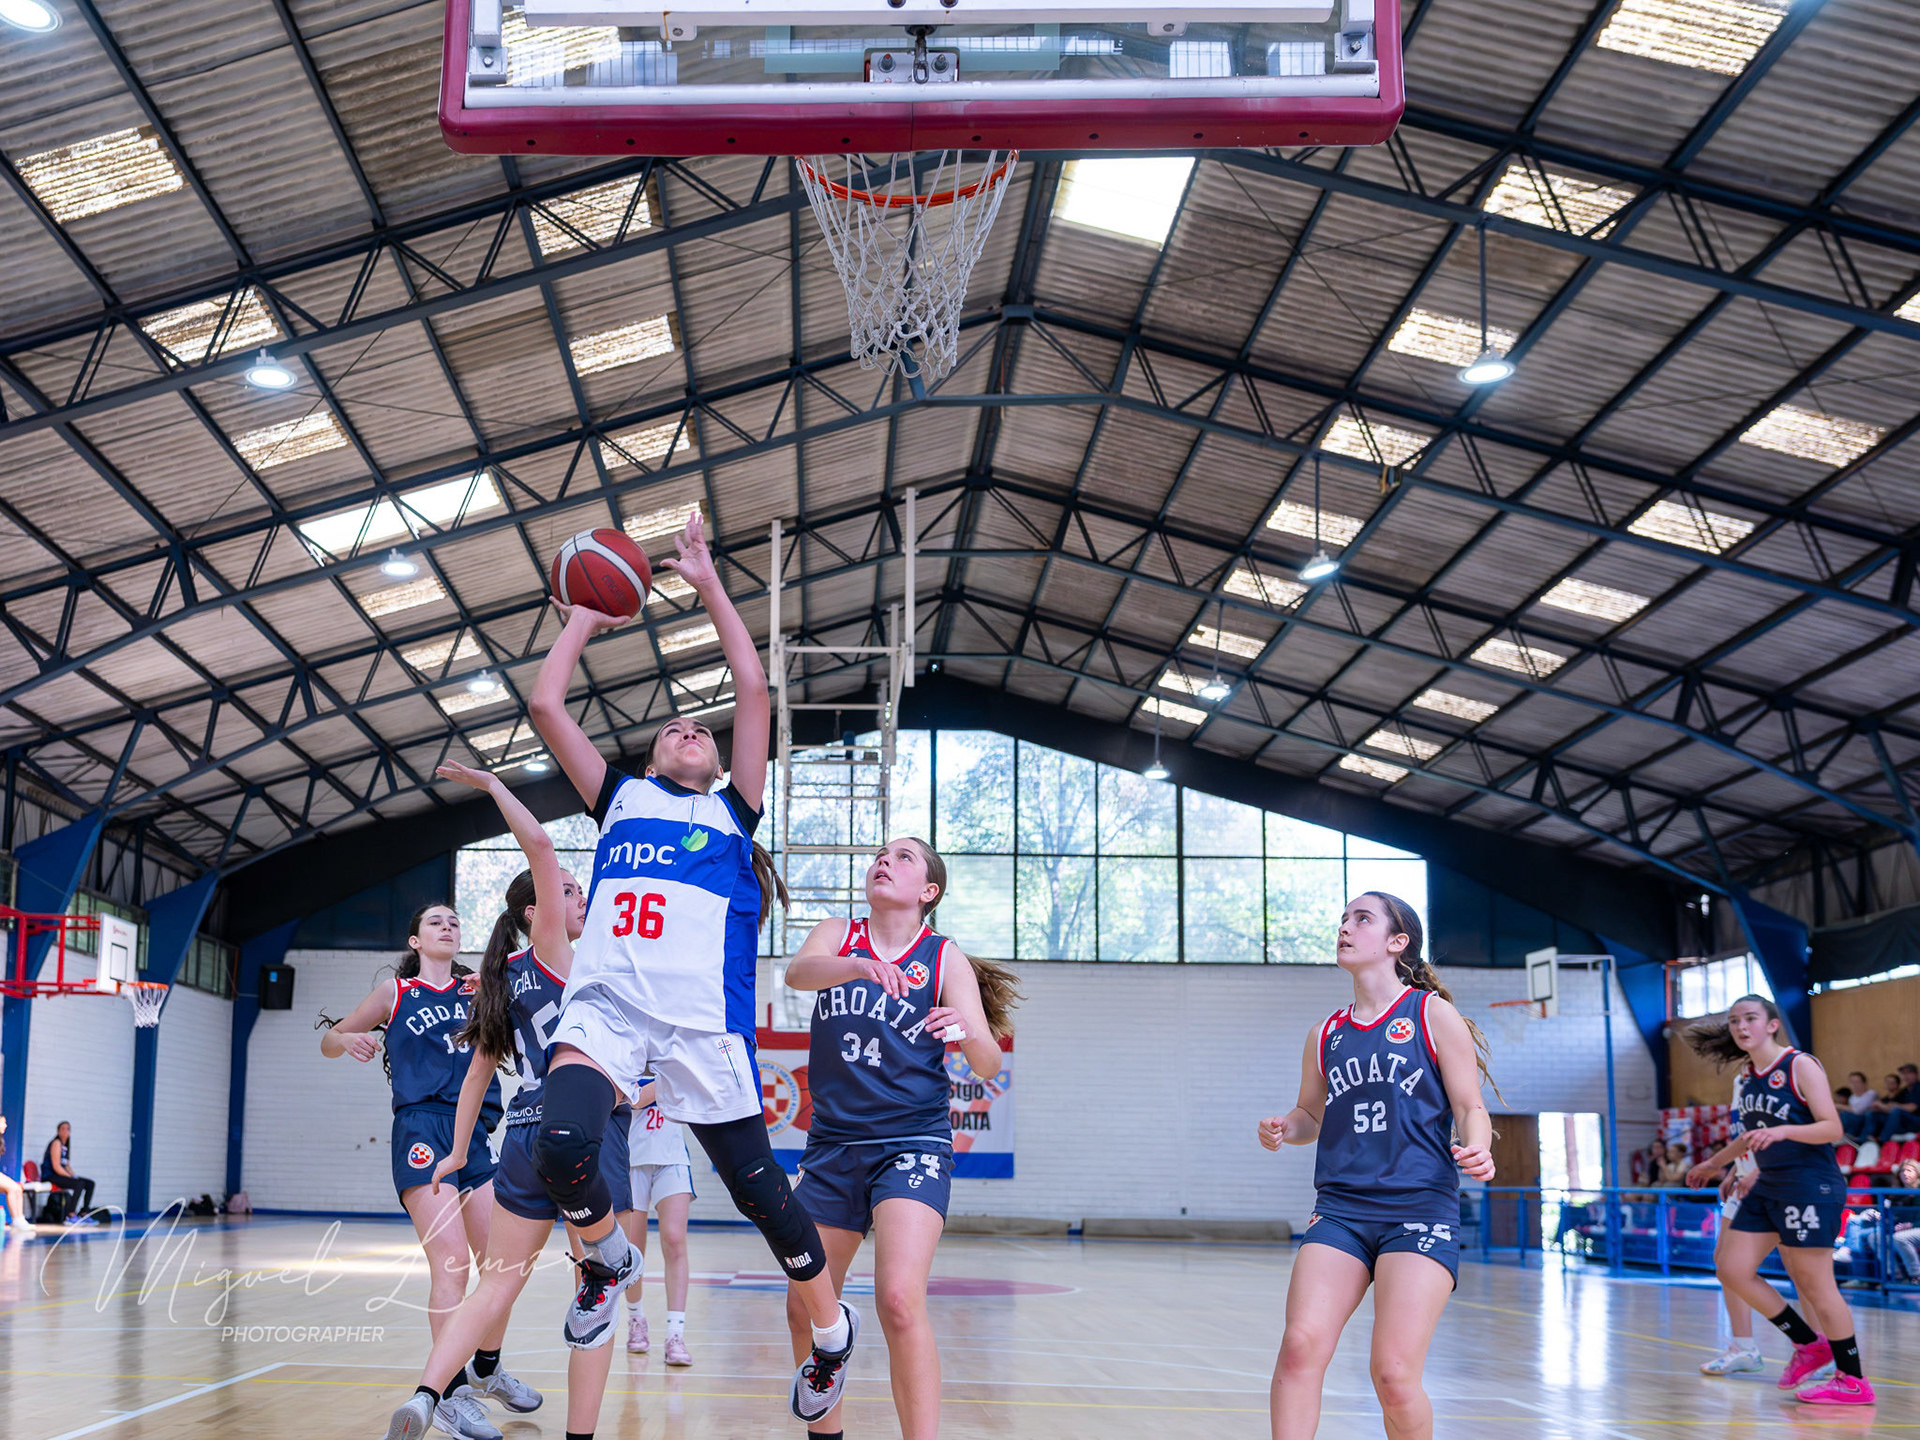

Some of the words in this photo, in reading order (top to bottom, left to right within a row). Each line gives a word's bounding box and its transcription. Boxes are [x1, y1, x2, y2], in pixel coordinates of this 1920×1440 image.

[613, 892, 666, 939] 36
[406, 1001, 474, 1035] CROA
[818, 986, 926, 1044] CROATA
[841, 1032, 881, 1067] 34
[646, 1108, 664, 1130] 26
[1354, 1100, 1387, 1133] 52
[1738, 1093, 1791, 1120] ROATA
[950, 1111, 991, 1130] OATA
[485, 1138, 499, 1164] 1
[571, 1207, 592, 1220] NBA
[1785, 1205, 1820, 1229] 24
[792, 1251, 812, 1269] NBA
